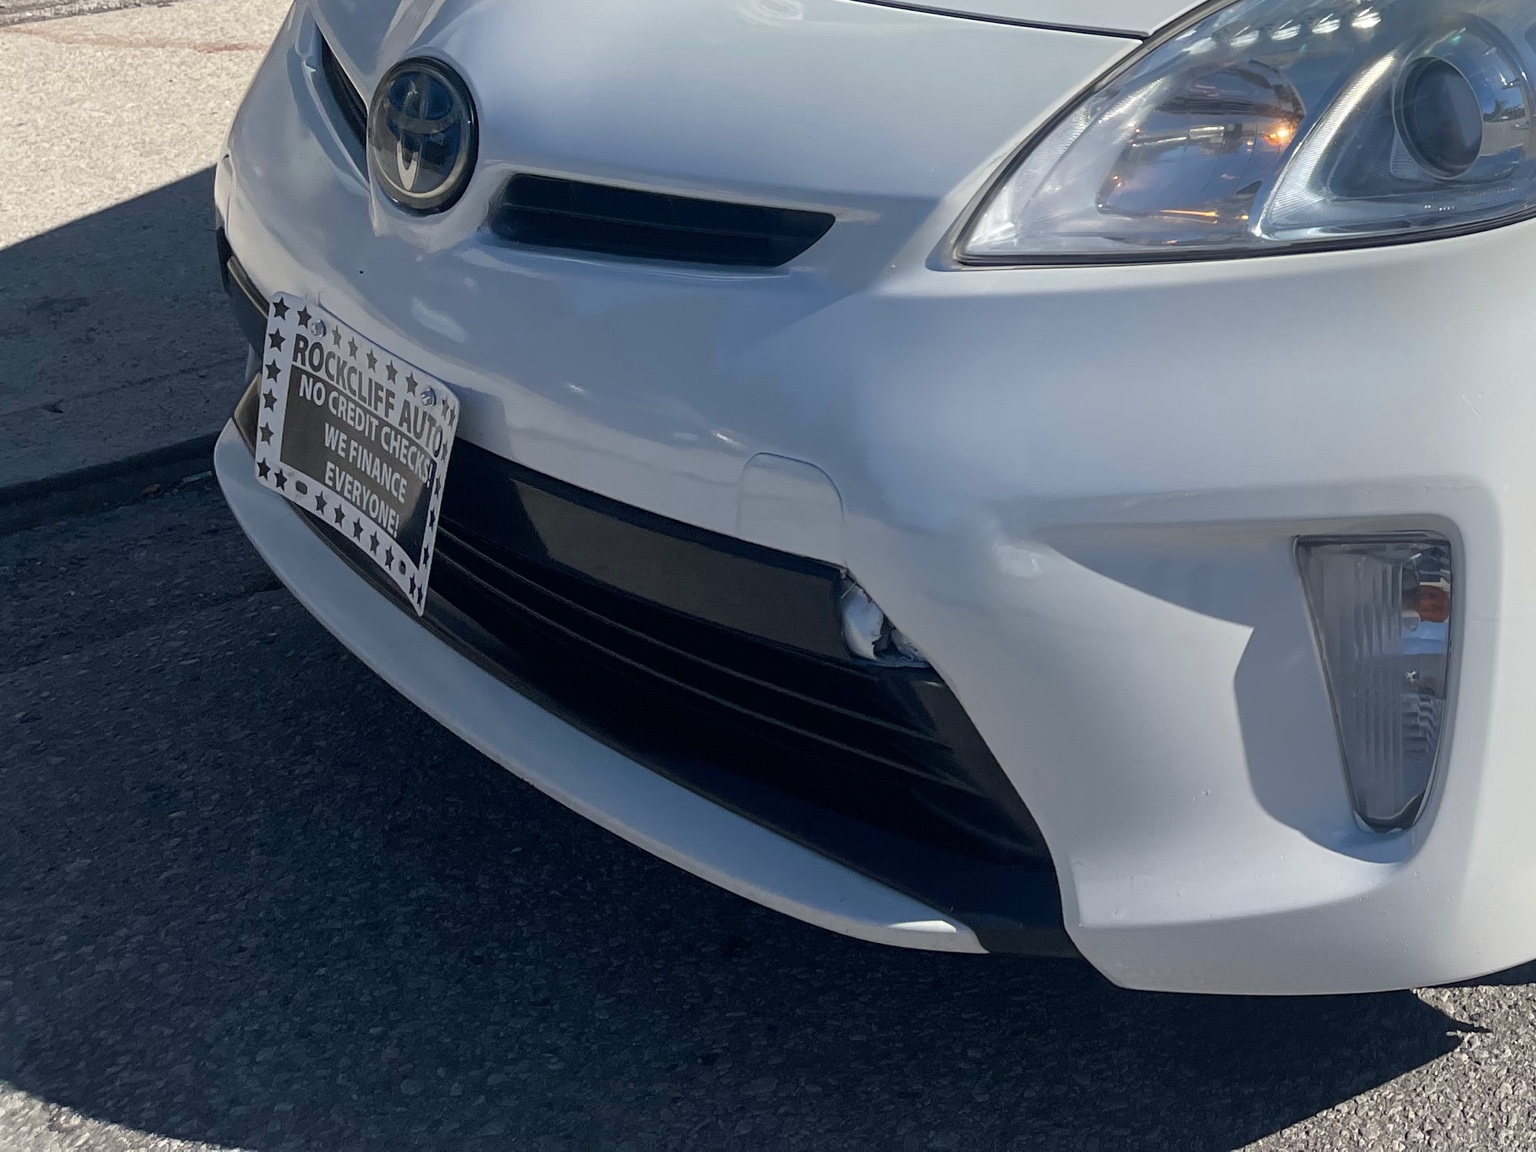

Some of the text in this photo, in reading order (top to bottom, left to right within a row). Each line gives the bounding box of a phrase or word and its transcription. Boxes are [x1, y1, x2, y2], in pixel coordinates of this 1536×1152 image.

[292, 332, 444, 460] ROCKCLIFF AUTO
[299, 373, 435, 488] NO CREDIT CHECKS!
[324, 422, 408, 504] WE FINANCE
[324, 460, 400, 539] EVERYONE!
